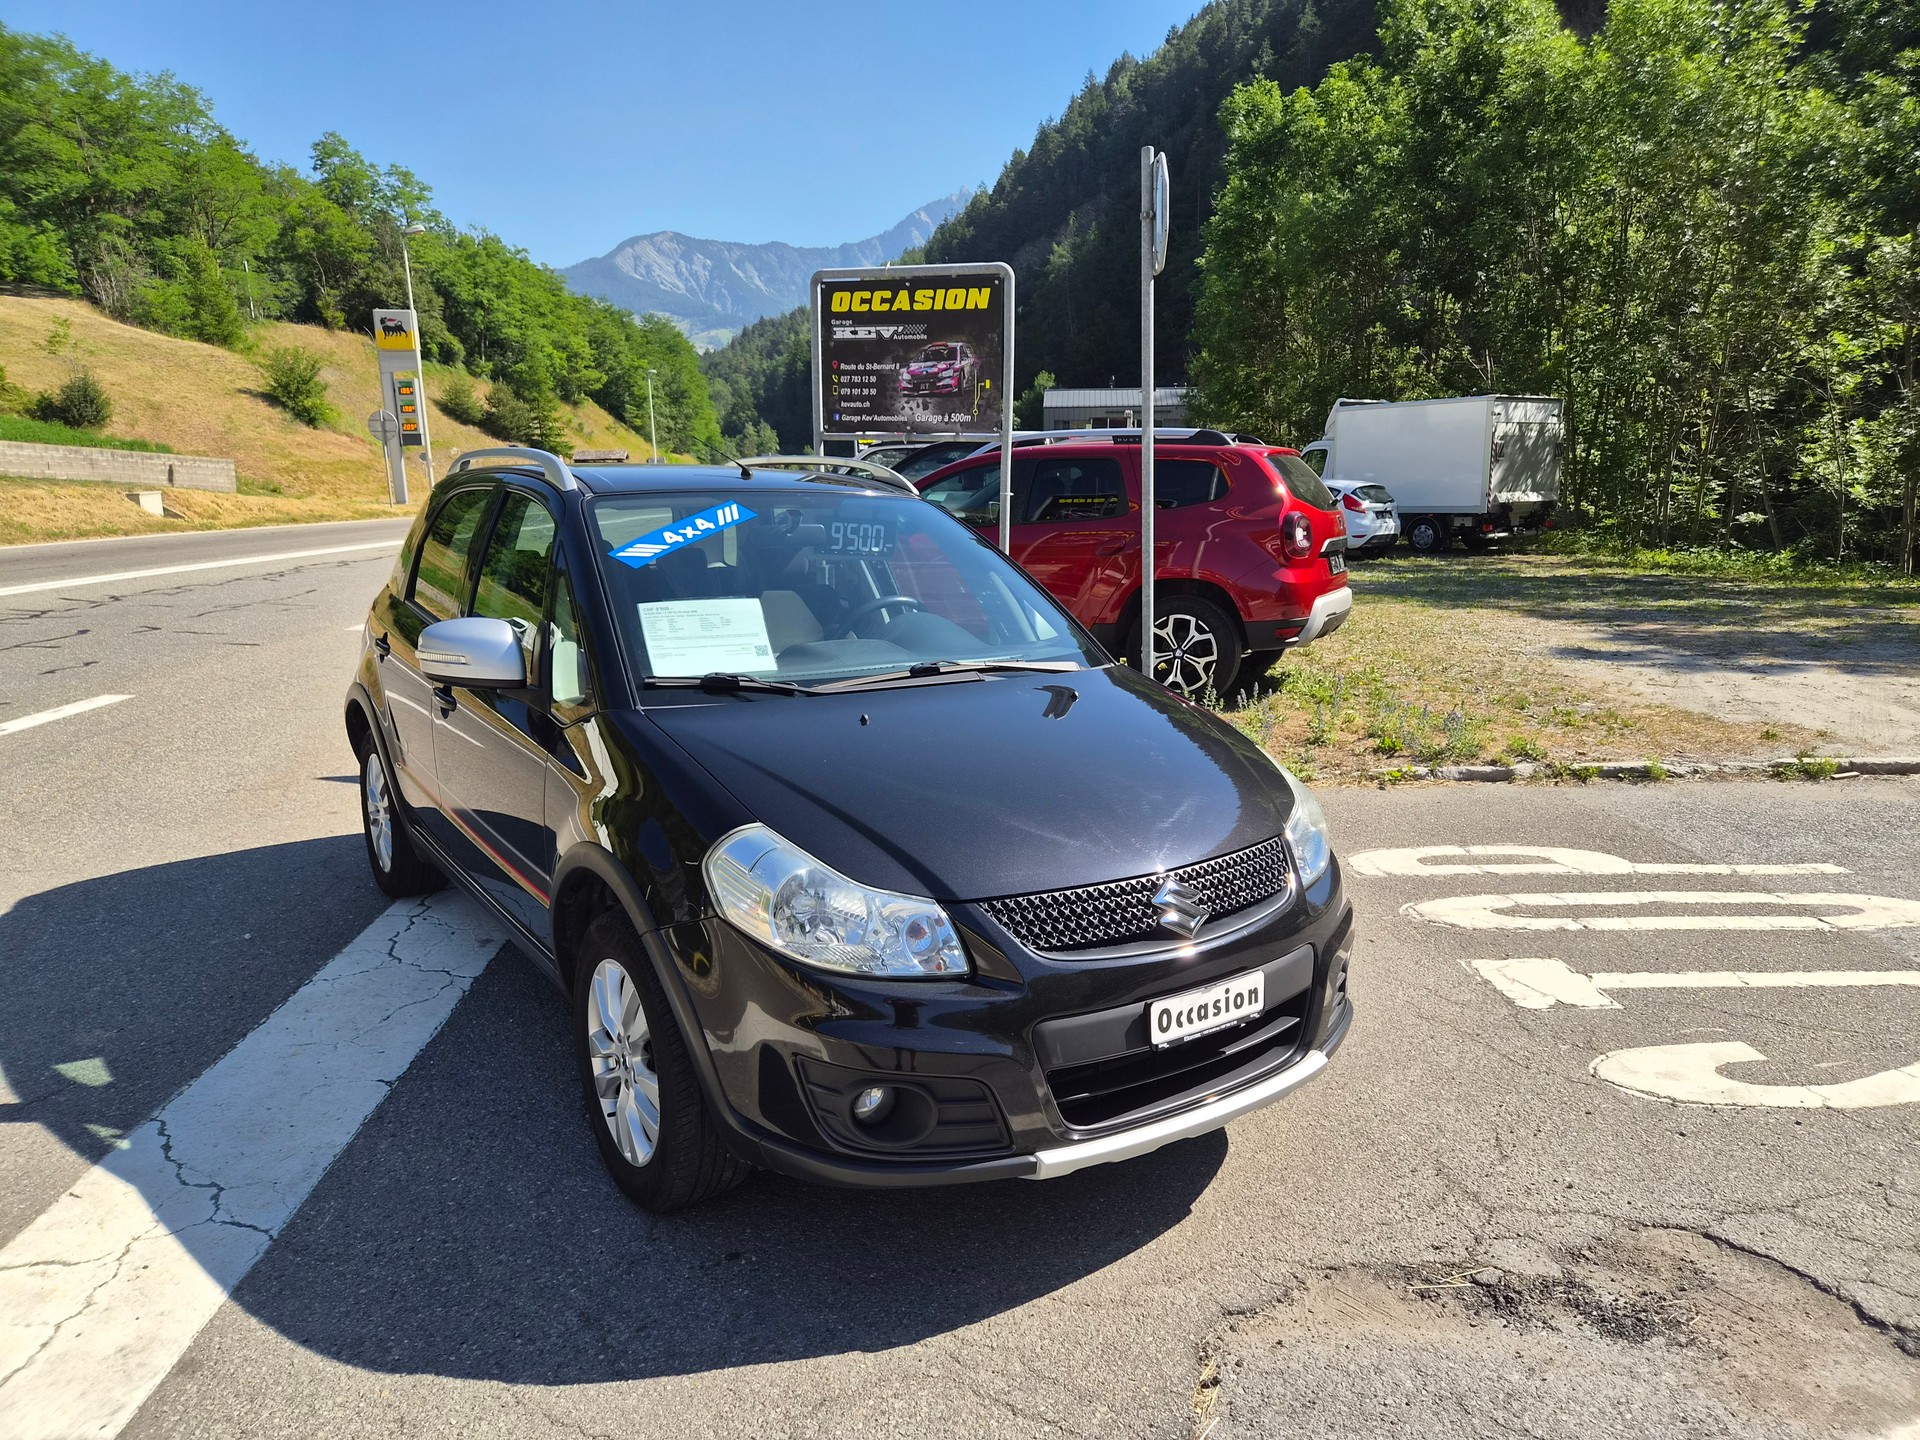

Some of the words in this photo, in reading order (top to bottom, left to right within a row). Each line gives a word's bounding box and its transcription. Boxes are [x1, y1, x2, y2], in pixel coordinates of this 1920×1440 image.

[831, 288, 991, 312] OCCASION
[841, 414, 861, 422] Garage
[915, 413, 942, 424] Garage
[943, 412, 949, 422] à
[950, 413, 971, 422] 500m
[1158, 987, 1259, 1034] Occasion
